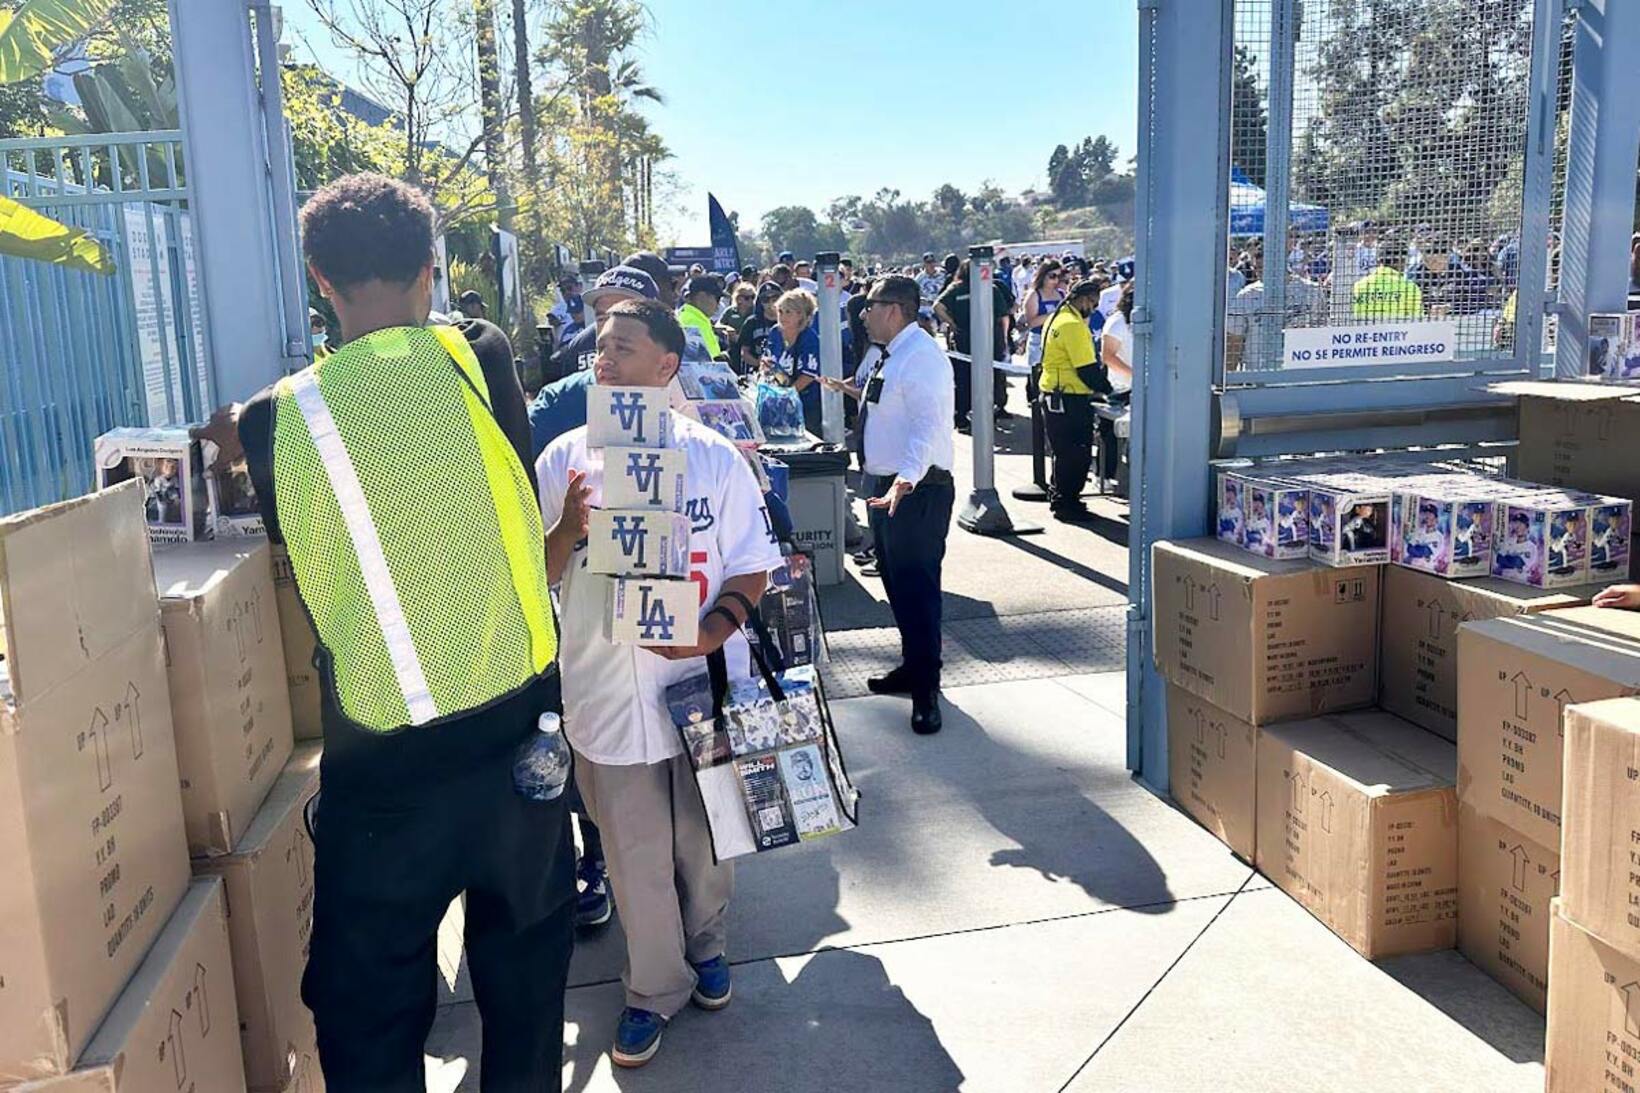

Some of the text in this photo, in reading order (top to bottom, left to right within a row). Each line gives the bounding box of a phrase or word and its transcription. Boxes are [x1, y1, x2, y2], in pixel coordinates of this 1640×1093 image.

[981, 267, 990, 280] 2
[824, 274, 836, 288] 2
[1332, 331, 1408, 345] NO RE-ENTRY
[1292, 343, 1445, 361] NO SE PERMITE REINGRESO
[796, 530, 832, 541] URITY
[637, 585, 675, 640] LA
[1499, 671, 1507, 680] UP
[1627, 767, 1639, 781] UP
[1604, 971, 1617, 984] UP
